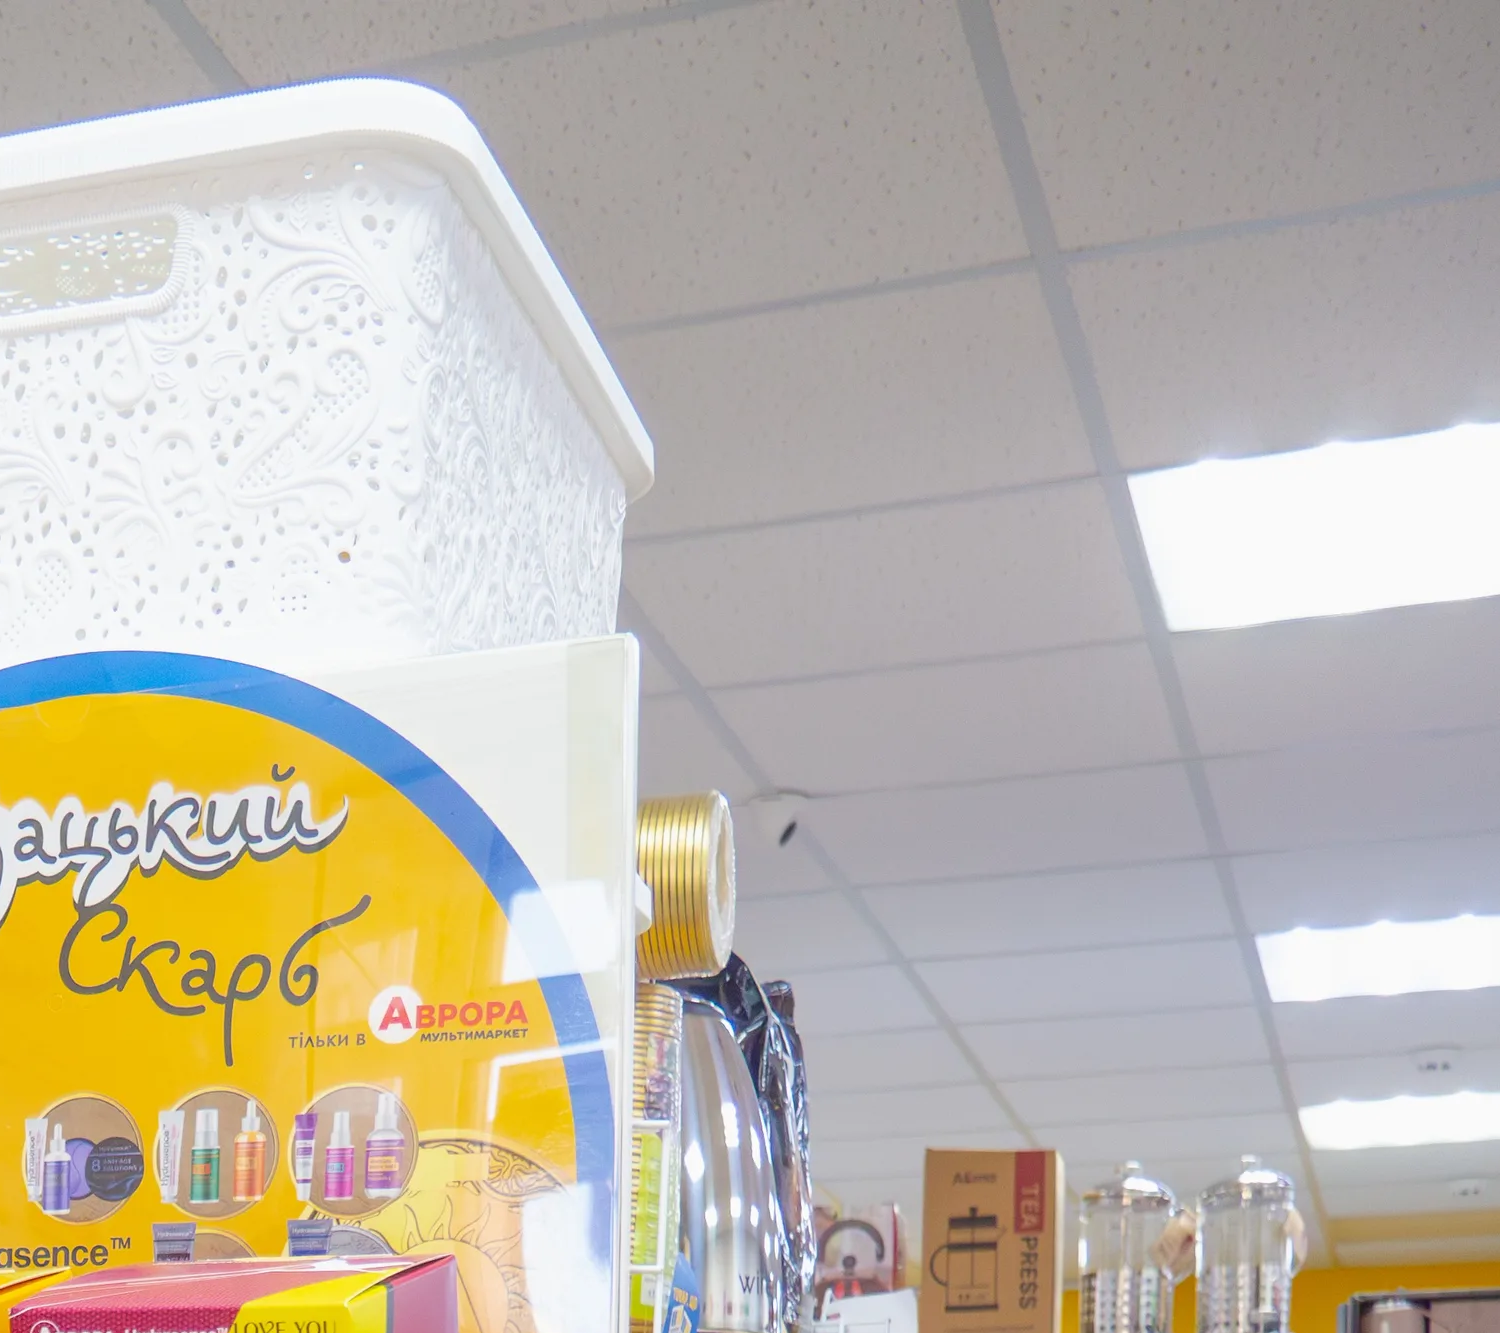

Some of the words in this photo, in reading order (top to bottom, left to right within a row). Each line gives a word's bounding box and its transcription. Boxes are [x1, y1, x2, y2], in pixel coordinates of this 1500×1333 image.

[59, 893, 371, 1066] Скарб
[420, 1028, 528, 1043] МУЛЬТИМАРКЕТ
[1021, 1236, 1038, 1312] PRESS
